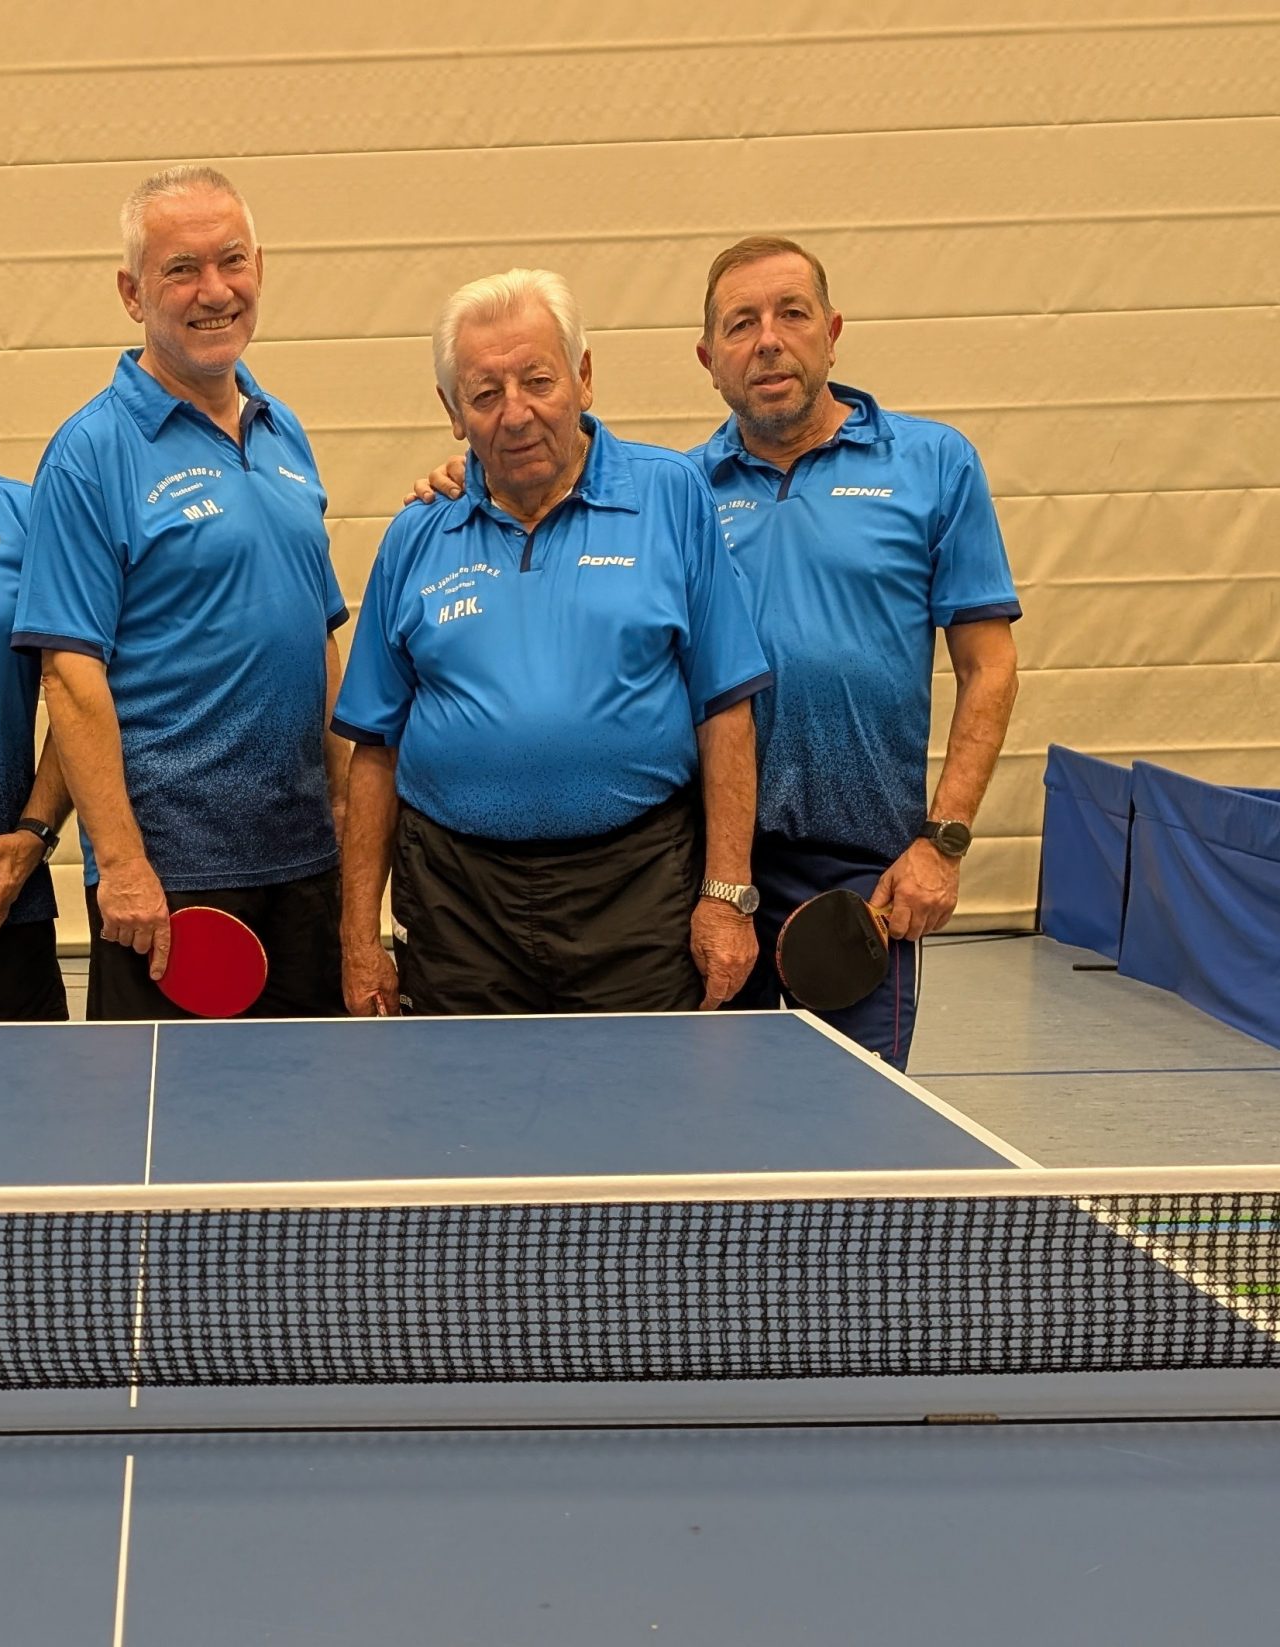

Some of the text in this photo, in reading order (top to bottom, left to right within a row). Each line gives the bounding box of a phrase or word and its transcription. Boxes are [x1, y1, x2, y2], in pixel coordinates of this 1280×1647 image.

[146, 489, 160, 504] TSV
[831, 487, 894, 498] DONIC
[182, 498, 224, 520] M.H.
[578, 554, 636, 567] DONIC
[438, 596, 483, 625] H.P.K.
